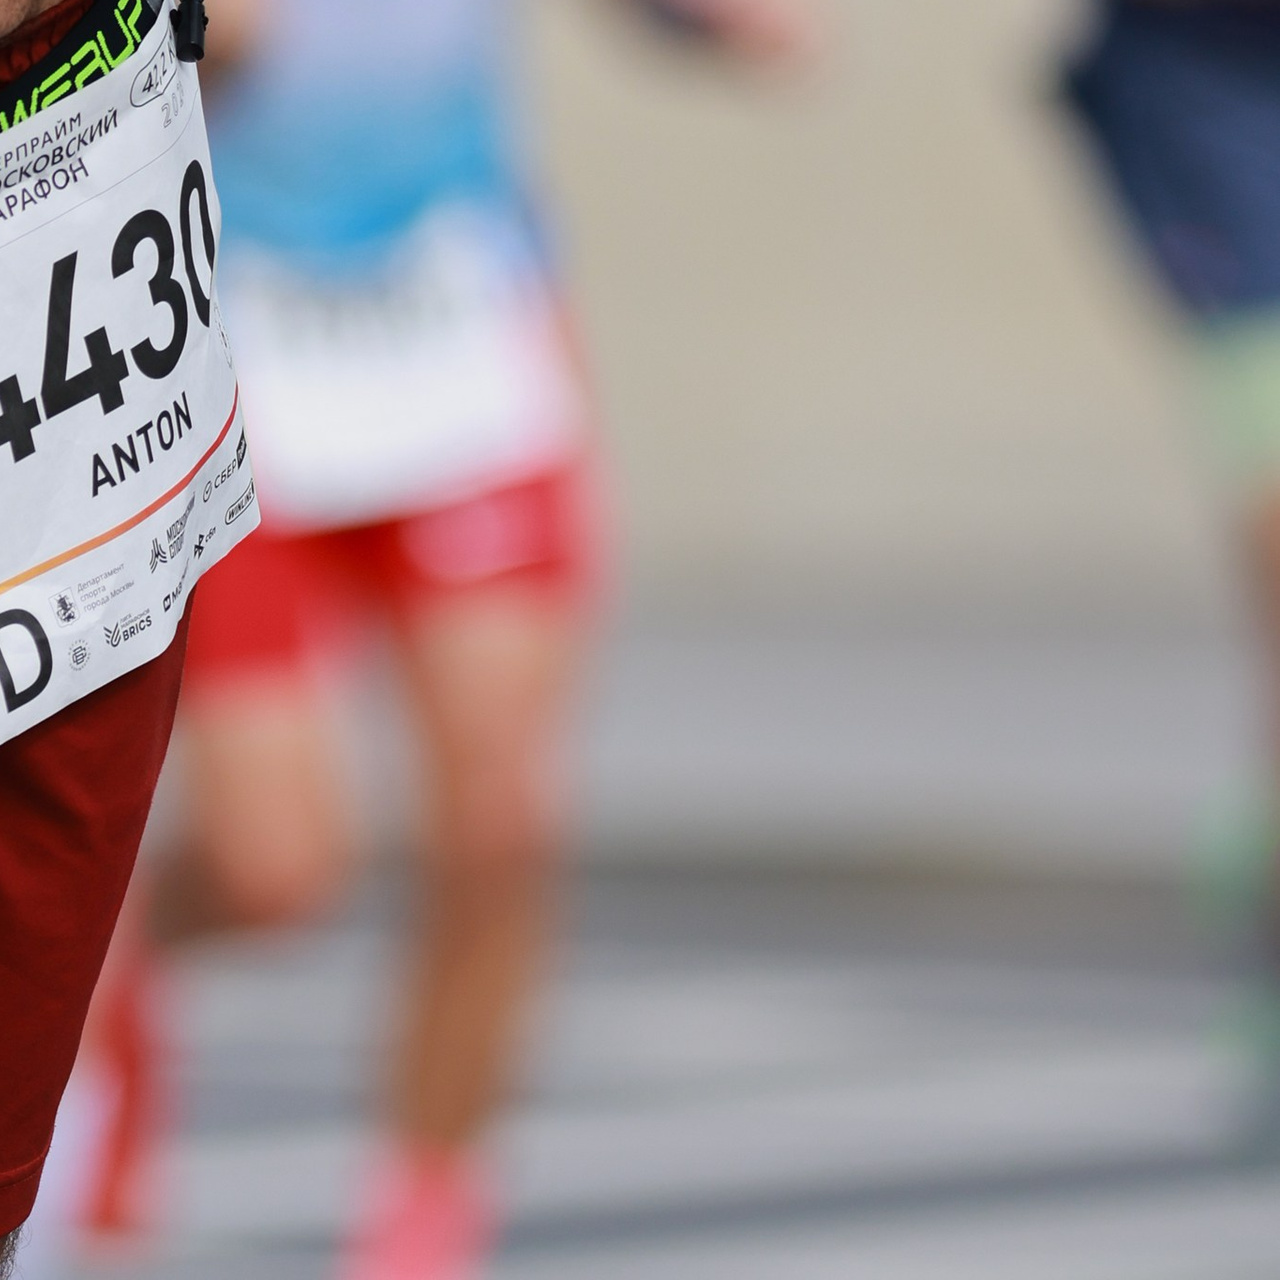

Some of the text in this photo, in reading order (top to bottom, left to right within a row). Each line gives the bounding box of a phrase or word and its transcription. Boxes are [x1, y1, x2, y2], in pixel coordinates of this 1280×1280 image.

[92, 390, 193, 498] ANTON
[77, 563, 125, 594] Департамент
[80, 585, 107, 603] спорта
[83, 580, 135, 613] города Москвы
[122, 615, 153, 642] BRICS
